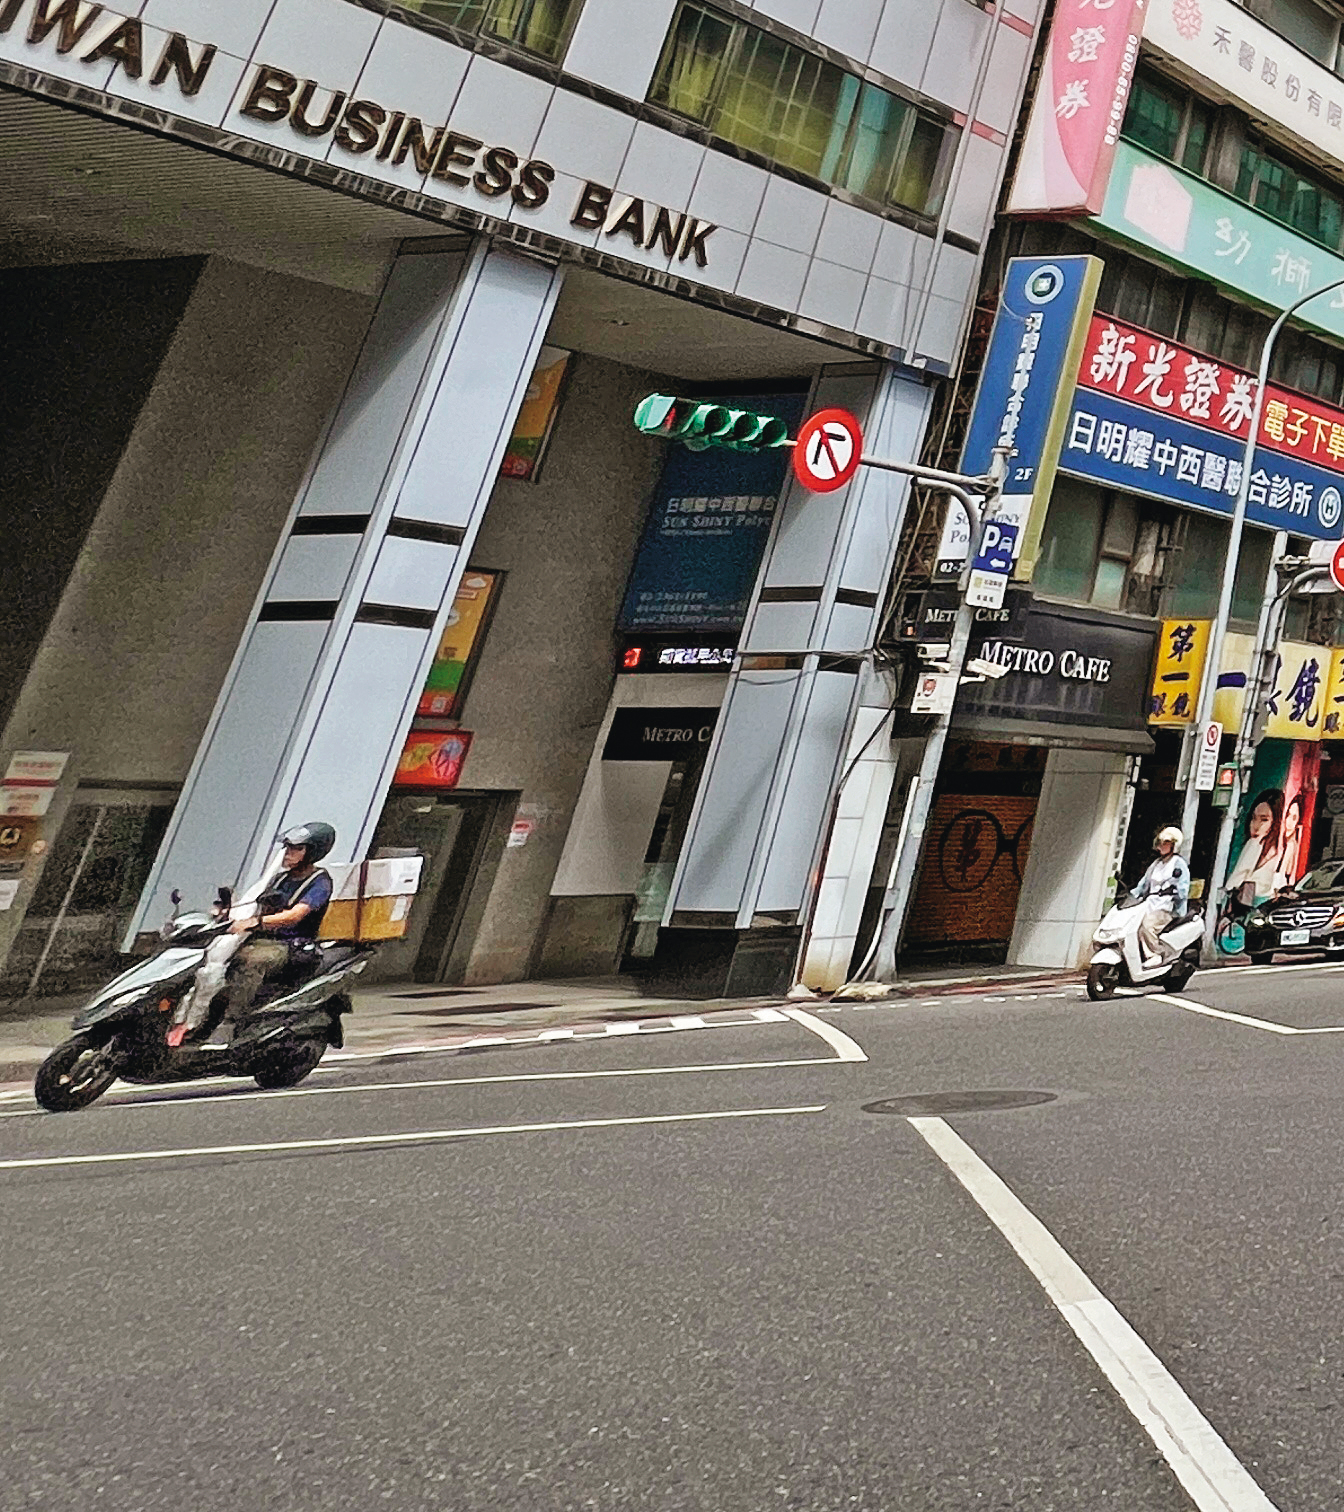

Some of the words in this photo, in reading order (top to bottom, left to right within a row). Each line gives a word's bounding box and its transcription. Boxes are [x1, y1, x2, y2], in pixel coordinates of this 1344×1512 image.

[240, 64, 555, 208] BUSINESS
[570, 179, 719, 268] BANK
[1090, 324, 1261, 432] 新光證券
[1013, 467, 1034, 482] 2F
[1068, 410, 1313, 518] 日明耀中西醫聯合診所
[979, 525, 1000, 558] P
[926, 608, 958, 623] MET
[980, 641, 1055, 675] METRO
[1060, 649, 1111, 682] CAFE
[1161, 624, 1197, 682] 第一
[642, 726, 693, 743] METRO
[697, 726, 713, 743] C
